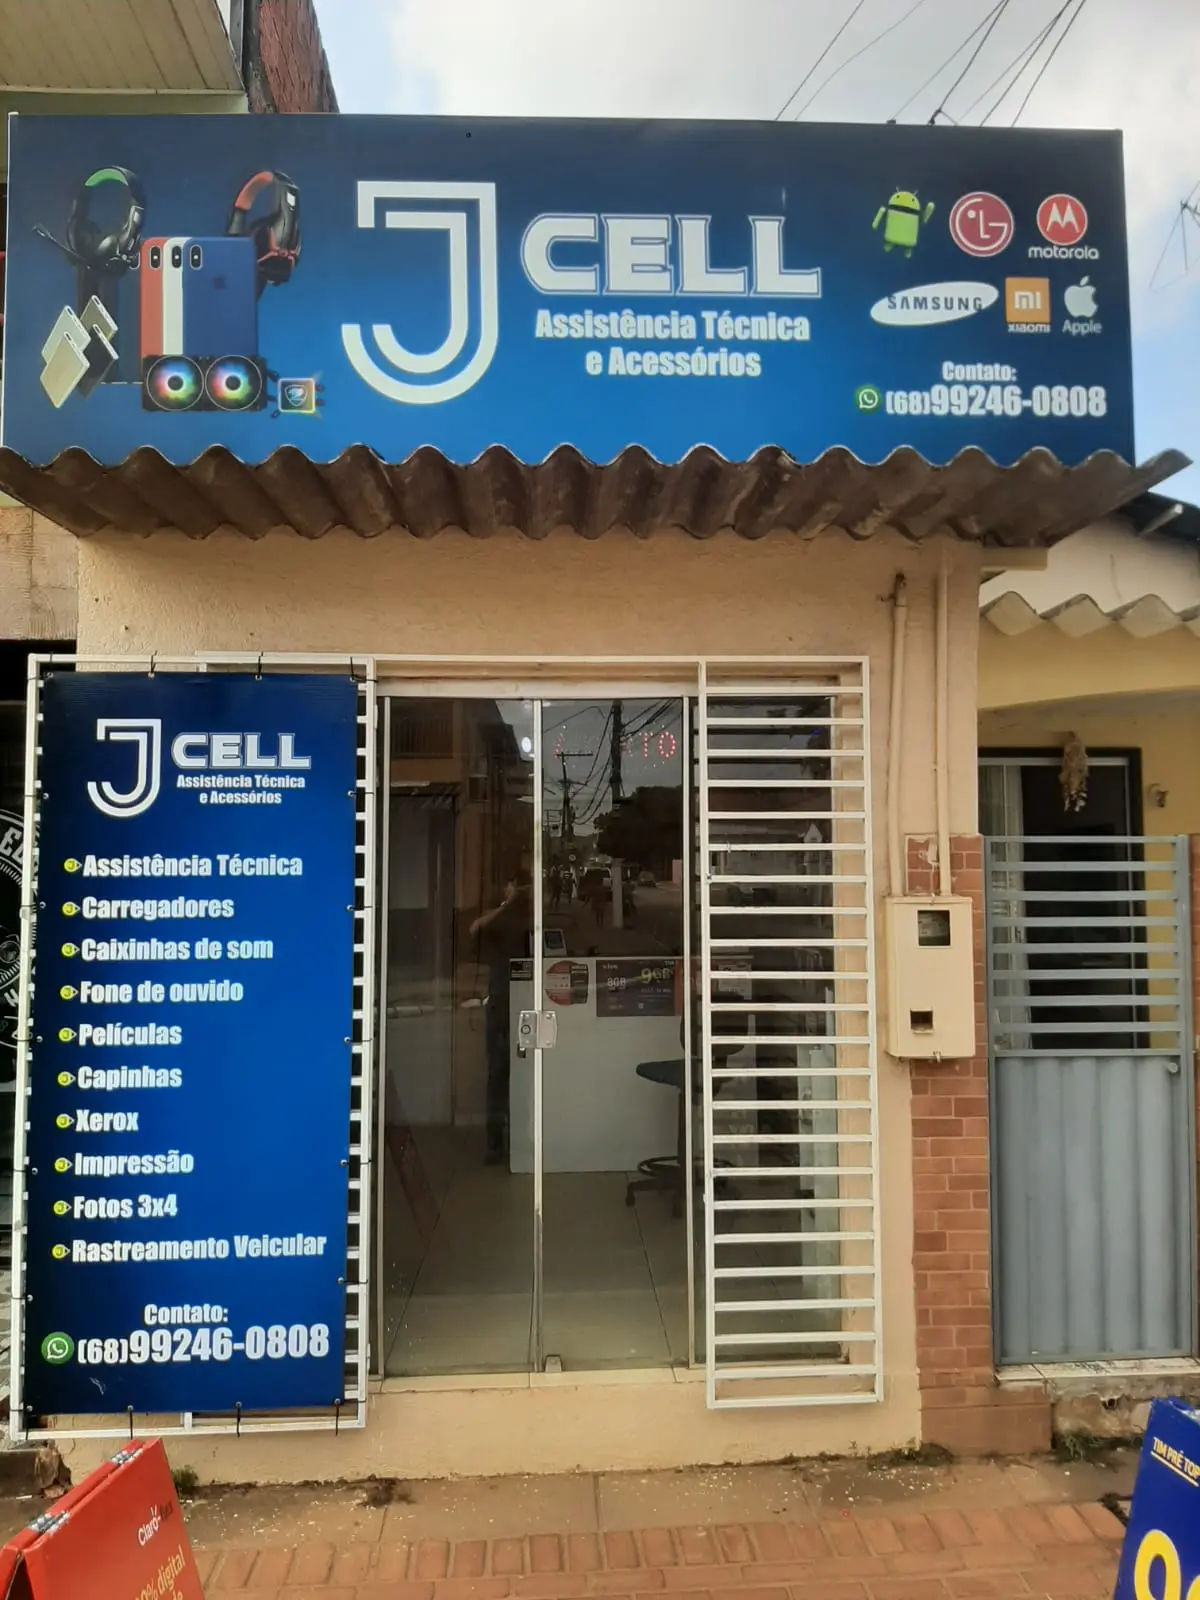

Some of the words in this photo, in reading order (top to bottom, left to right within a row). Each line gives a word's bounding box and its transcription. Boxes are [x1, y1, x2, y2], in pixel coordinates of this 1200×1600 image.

[519, 212, 822, 299] CELL
[1027, 245, 1100, 260] motorola
[887, 296, 983, 311] SAMSUNG
[534, 308, 697, 339] Assistência
[700, 309, 811, 341] Técnica
[1062, 319, 1102, 336] Apple
[585, 350, 604, 376] e
[607, 345, 762, 377] Acessórios
[941, 360, 1018, 382] Contato:
[885, 384, 1107, 417] (68)99246-0808
[170, 732, 312, 770] CELL
[176, 774, 252, 789] Assistência
[254, 774, 306, 789] Técnica
[199, 792, 208, 804] e
[209, 789, 282, 805] Acessórios
[82, 853, 212, 877] Assistência
[215, 853, 303, 877] Técnica
[82, 895, 235, 921] Carregadores
[81, 937, 191, 962] Caixinhas
[194, 937, 223, 960] de
[226, 940, 274, 960] som
[79, 980, 133, 1004] Fone
[136, 980, 166, 1003] de
[169, 979, 244, 1003] ouvido
[78, 1022, 183, 1047] Películas
[77, 1065, 183, 1091] Capinhas
[75, 1109, 139, 1133] Xerox
[74, 1149, 194, 1178] Impressão
[73, 1195, 133, 1219] Fotos
[137, 1193, 178, 1218] 3x4
[72, 1237, 230, 1263] Rastreamento
[233, 1232, 328, 1259] Veicular
[143, 1303, 229, 1327] Contato:
[77, 1323, 330, 1365] (68)99246-0808
[1153, 1436, 1168, 1459] TIM
[138, 1515, 160, 1547] Claro
[157, 1544, 186, 1596] digital
